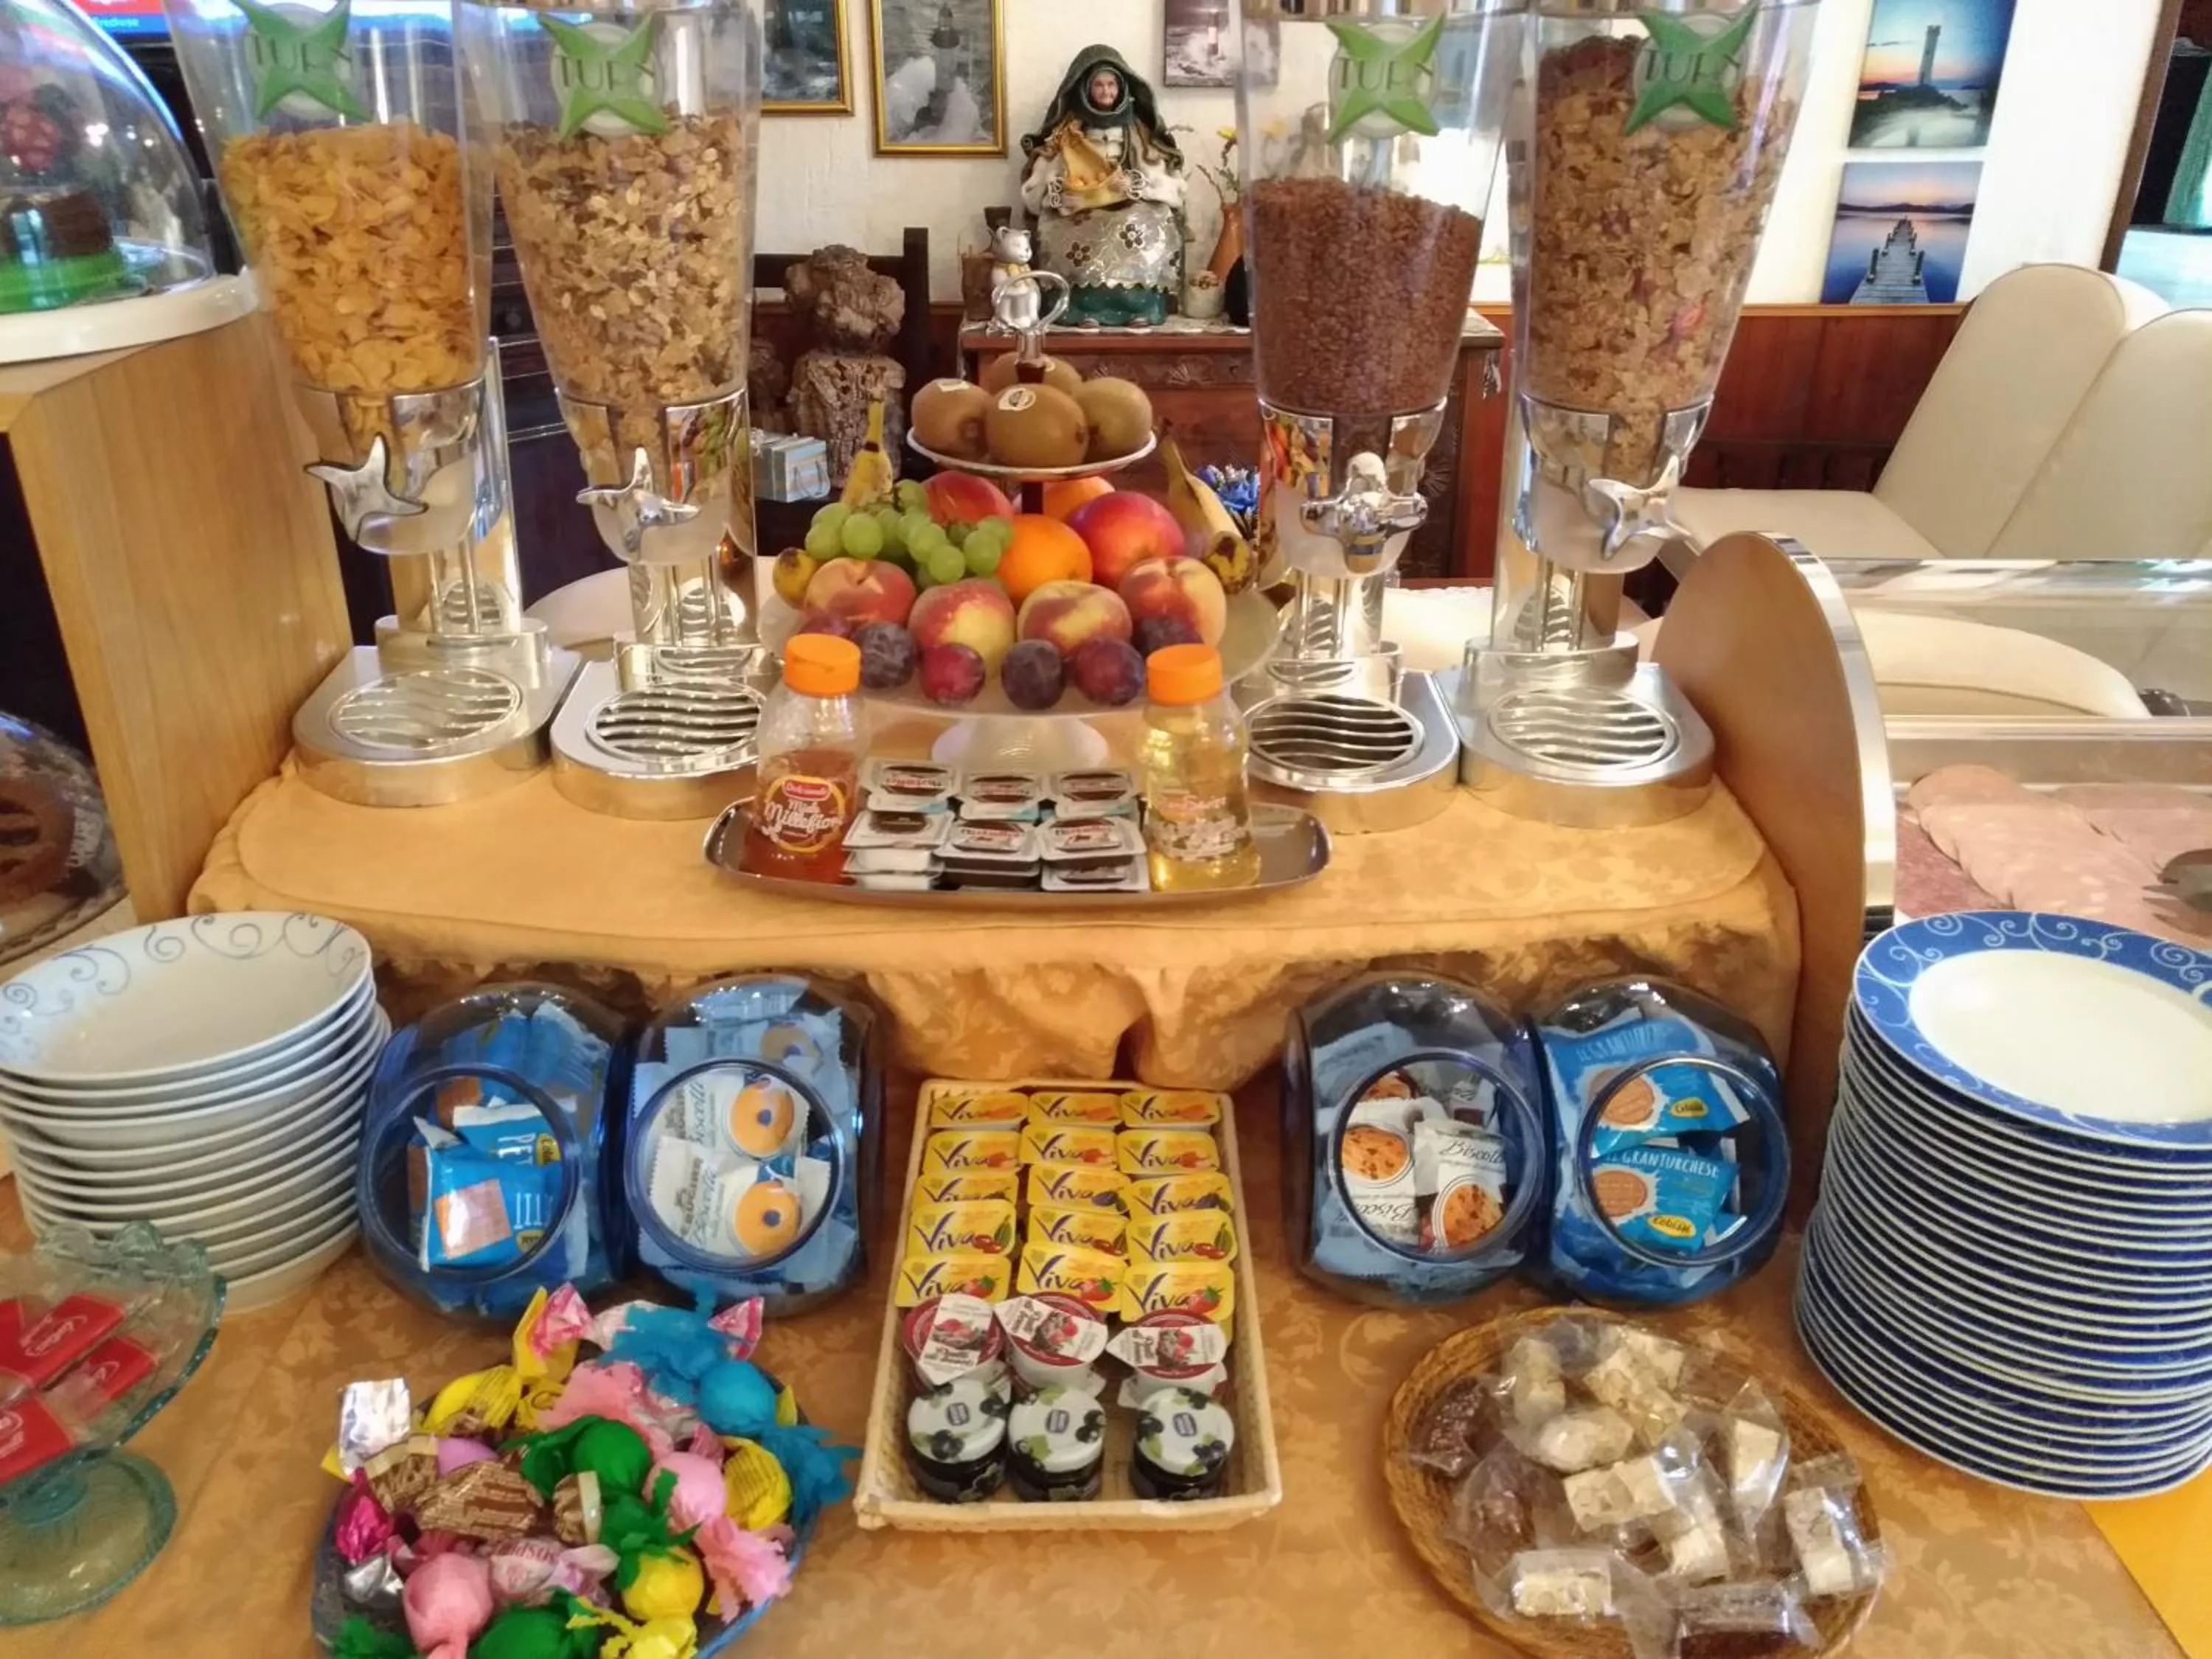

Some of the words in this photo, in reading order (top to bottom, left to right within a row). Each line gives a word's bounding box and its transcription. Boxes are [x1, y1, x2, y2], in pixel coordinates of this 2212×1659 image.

[1027, 1133, 1082, 1160] Viva
[1124, 1138, 1180, 1167] Viva
[1035, 1170, 1093, 1200] Viva
[1133, 1182, 1194, 1215] Viva
[913, 1211, 975, 1252] Viva
[1034, 1214, 1093, 1244] Viva
[1130, 1222, 1194, 1262] Viva
[902, 1262, 967, 1298] Viva
[1023, 1254, 1085, 1289] Viva
[1125, 1272, 1192, 1312] Viva
